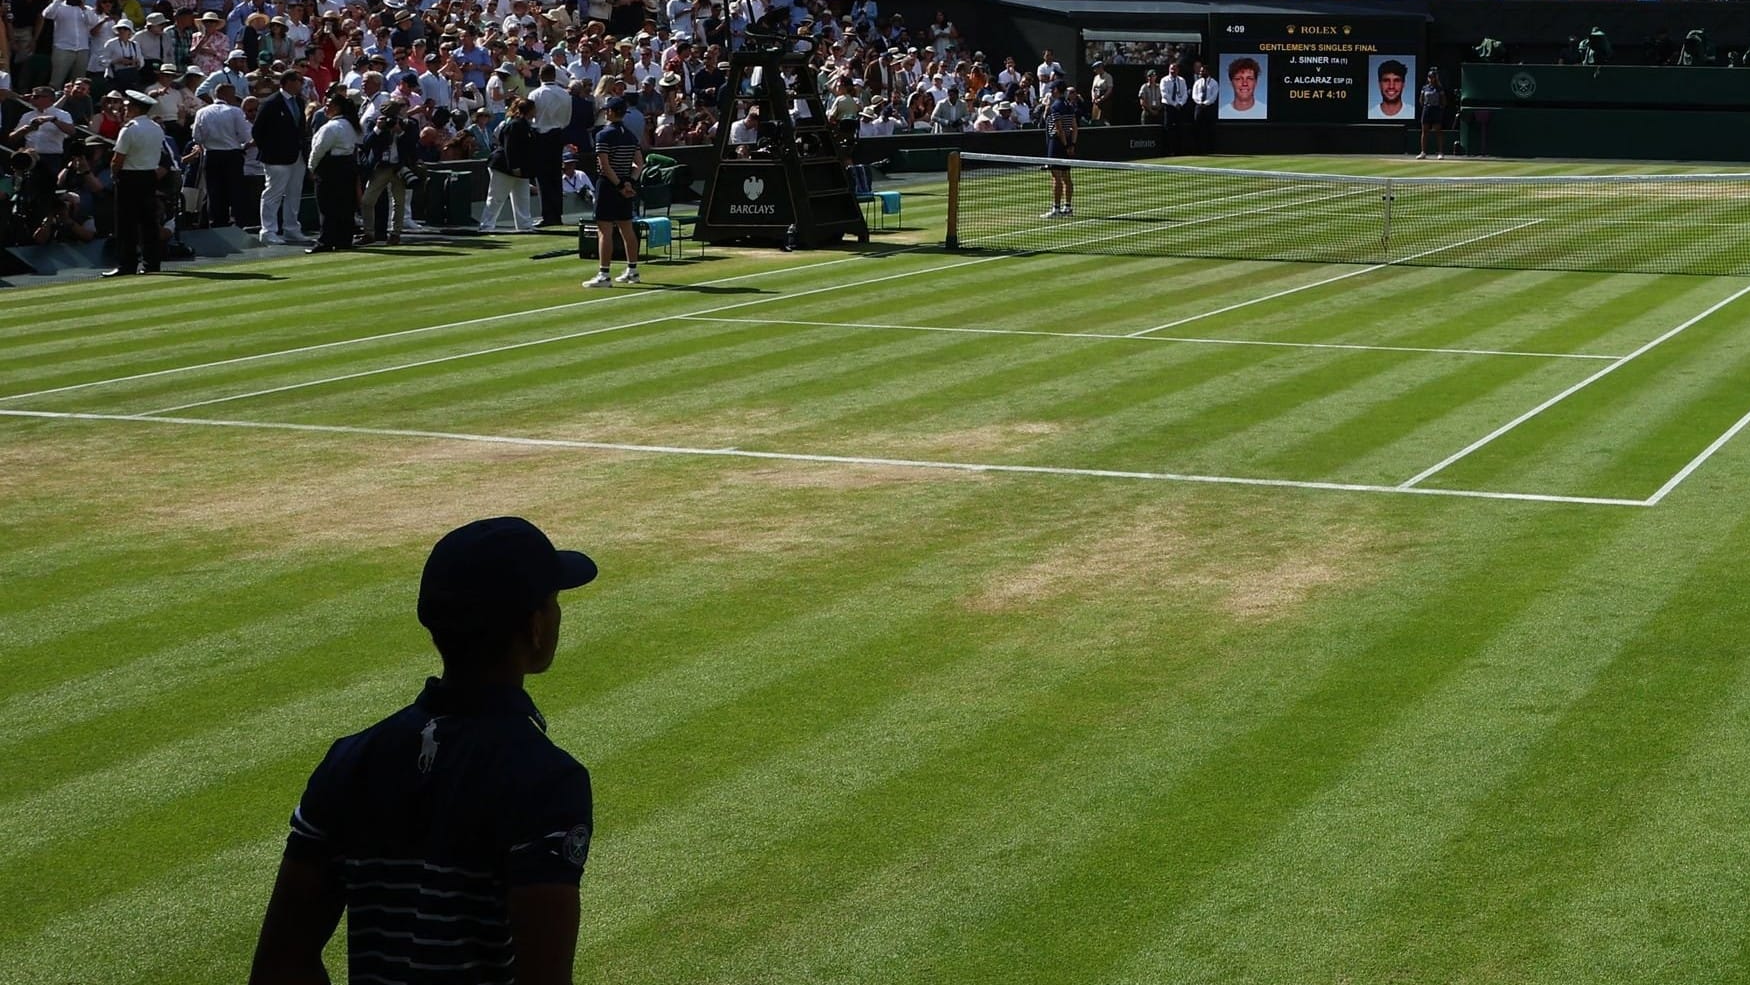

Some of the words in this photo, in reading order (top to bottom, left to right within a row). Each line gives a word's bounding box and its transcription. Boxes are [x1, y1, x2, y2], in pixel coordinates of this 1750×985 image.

[1226, 25, 1245, 34] 4:09
[1300, 26, 1338, 34] ROLEX
[1259, 43, 1317, 52] GENTLEMEN'S
[1318, 44, 1353, 52] SINGLES
[1289, 56, 1297, 64] J.
[1298, 56, 1329, 64] SINNER
[1284, 76, 1292, 84] C.
[1294, 76, 1332, 84] ALCARAZ
[1289, 90, 1310, 99] DUE
[1311, 90, 1324, 99] AT
[1326, 90, 1347, 99] 4:10
[729, 204, 776, 215] BARCLAYS
